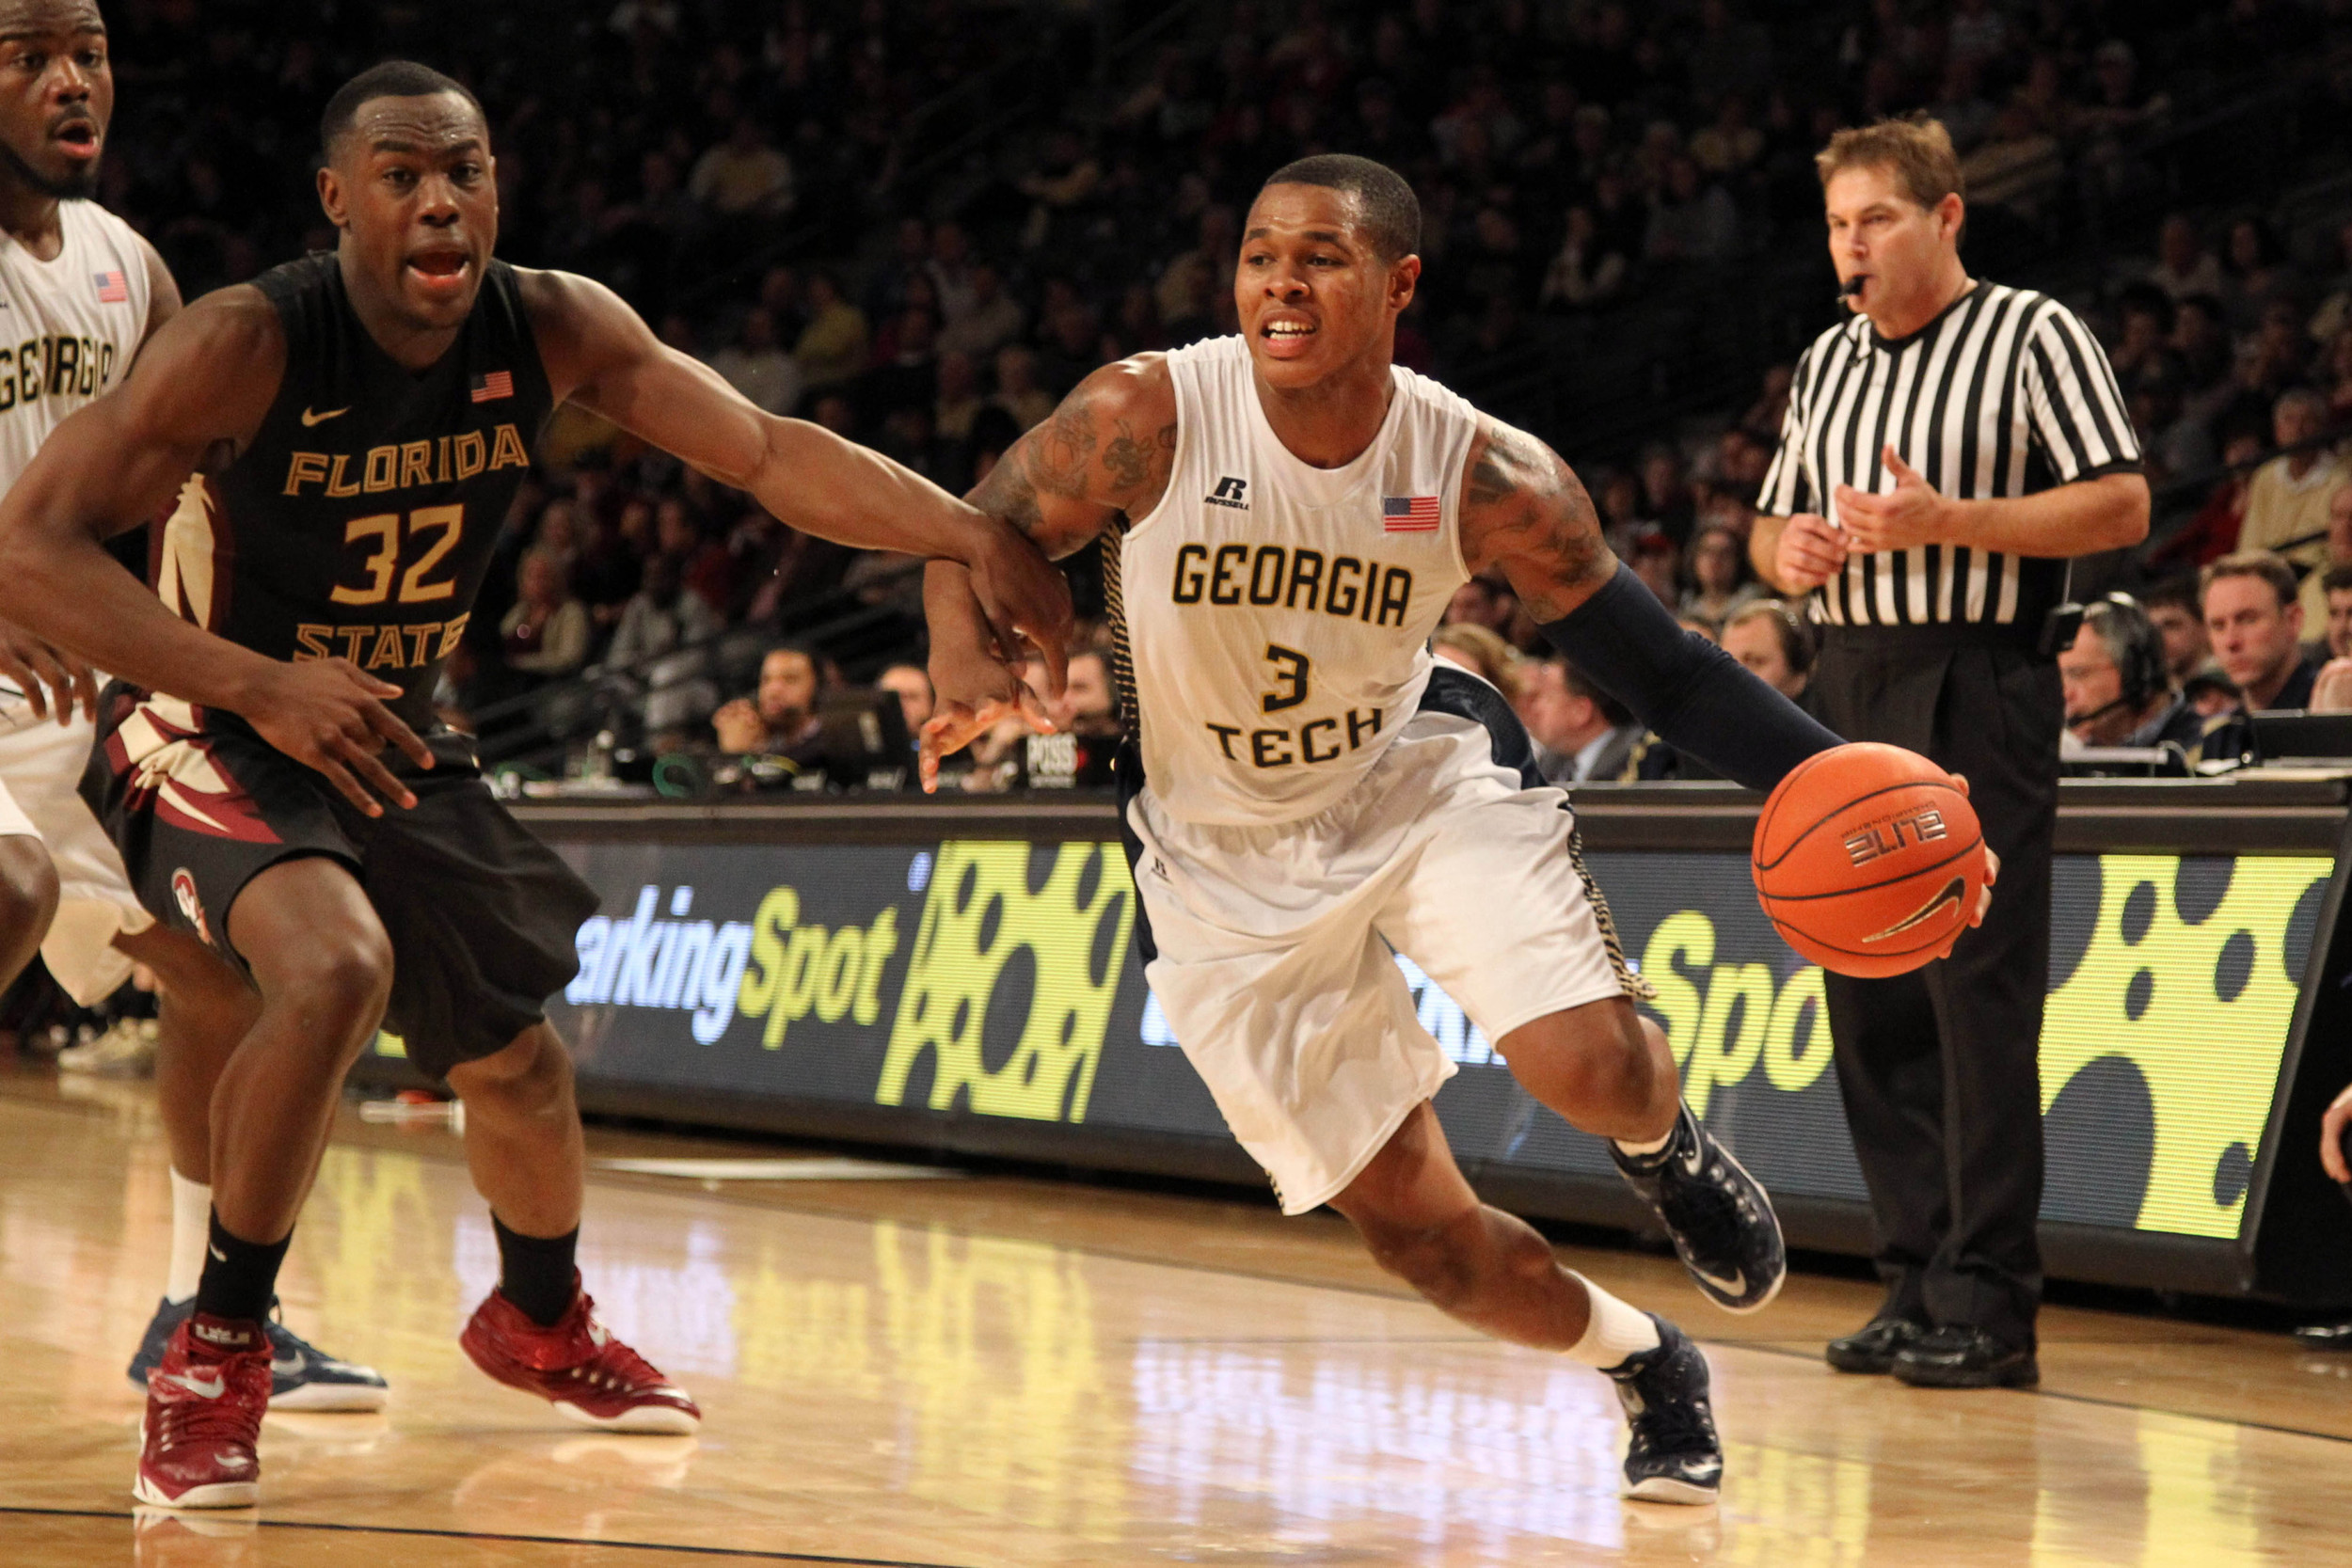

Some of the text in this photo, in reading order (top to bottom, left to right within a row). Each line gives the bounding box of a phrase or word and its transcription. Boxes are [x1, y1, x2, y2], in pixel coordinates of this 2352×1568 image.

[281, 423, 531, 498] FLORIDA
[330, 502, 465, 606] 32
[1172, 543, 1413, 628] GEORGIA
[293, 610, 470, 670] STATE
[1262, 642, 1311, 714] 3
[1204, 706, 1383, 768] TECH
[1844, 810, 1947, 867] ELITE
[565, 884, 898, 1052] arkingSpot
[1642, 910, 1835, 1121] Spo
